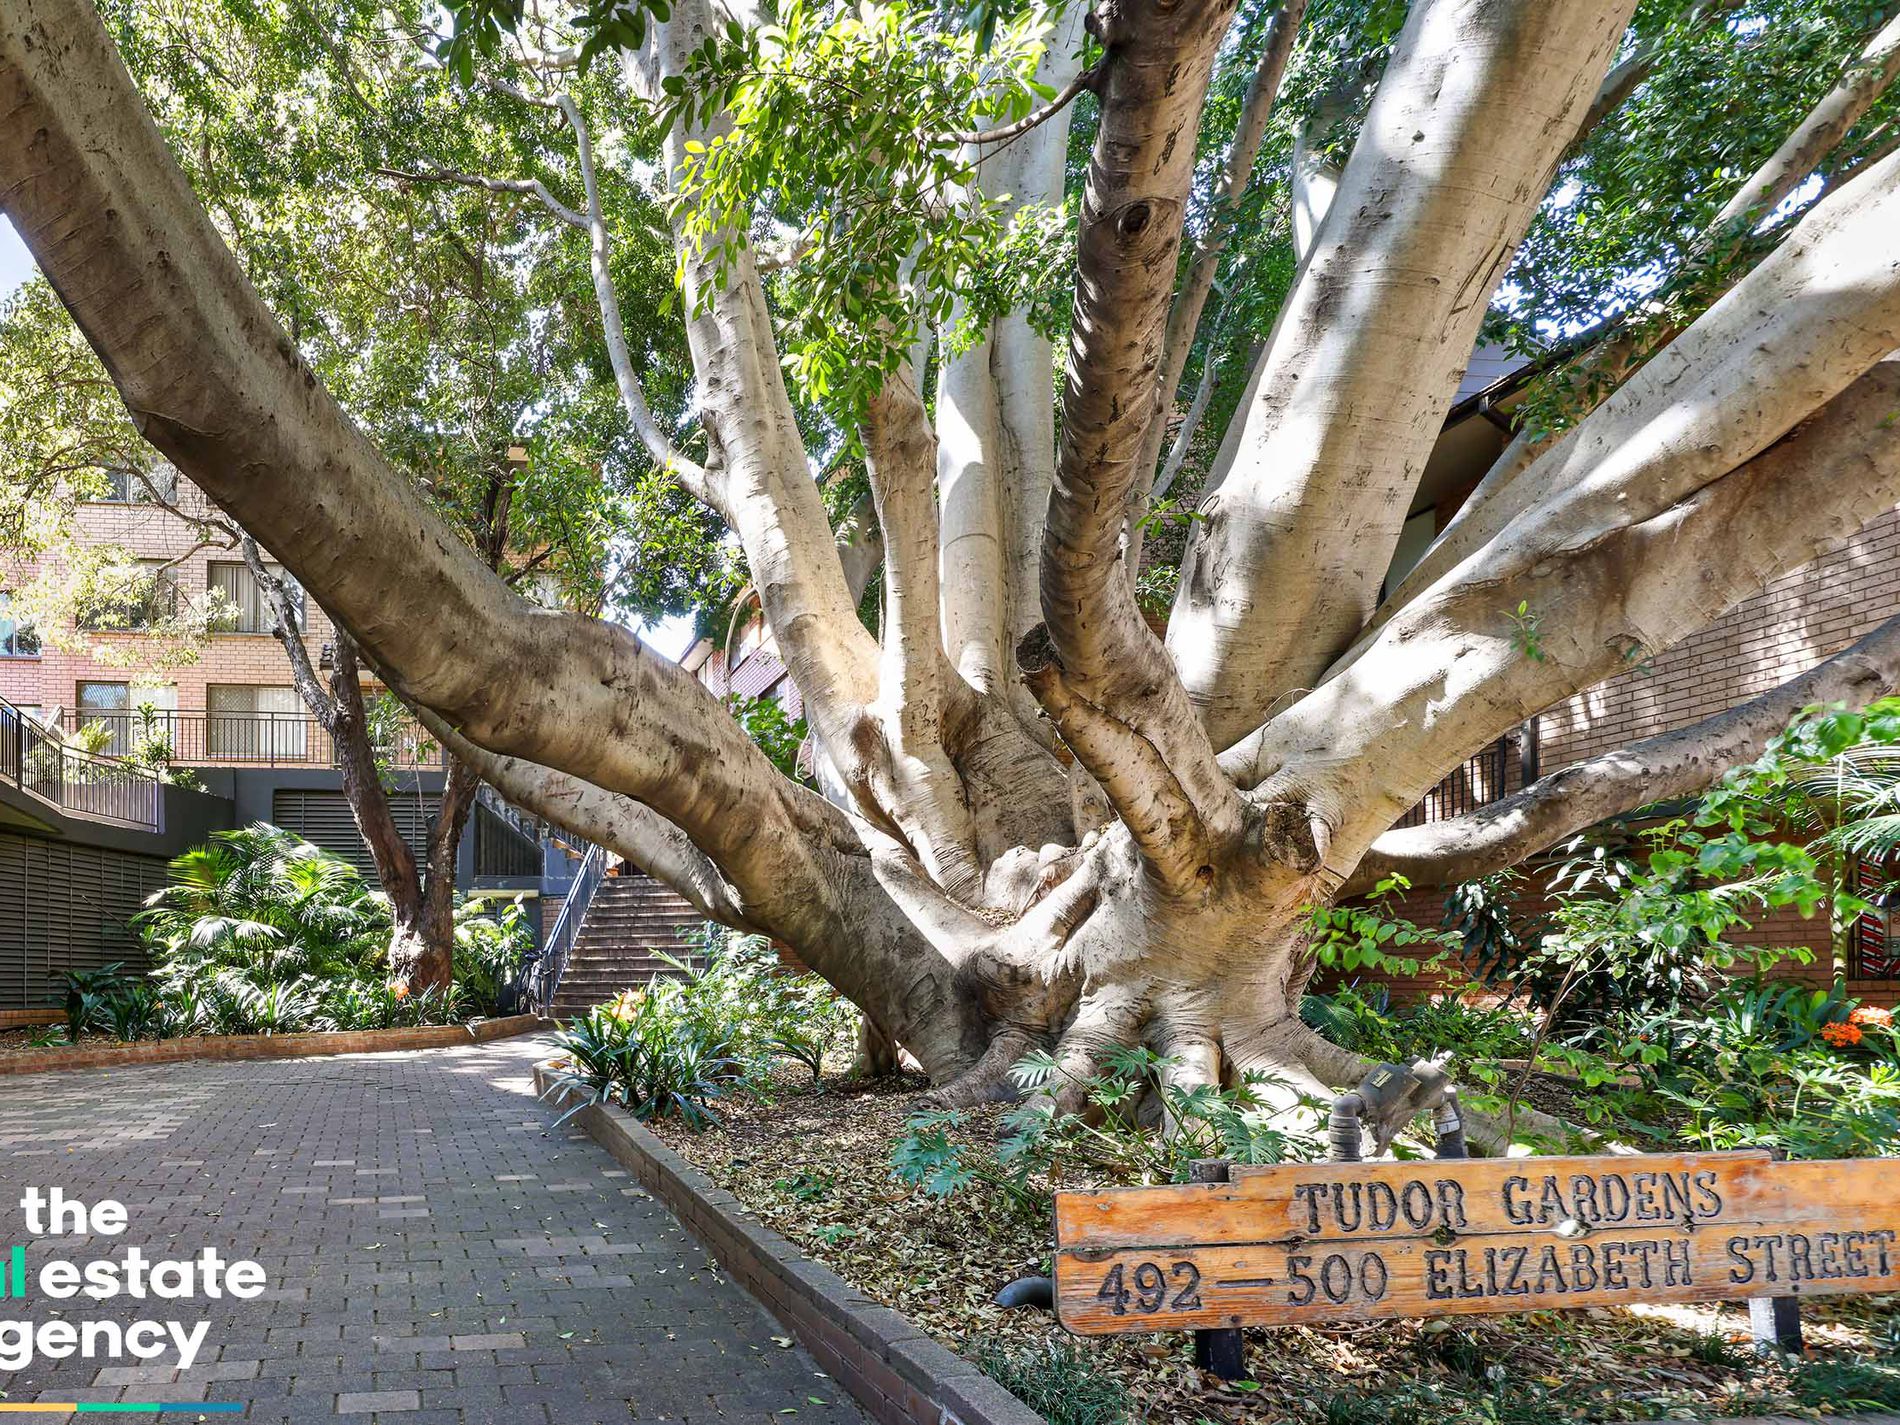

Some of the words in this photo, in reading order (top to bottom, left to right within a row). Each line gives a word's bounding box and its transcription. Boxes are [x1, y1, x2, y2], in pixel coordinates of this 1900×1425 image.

[1295, 1178, 1468, 1233] TUDOR
[1500, 1170, 1724, 1225] GARDENS
[1424, 1238, 1694, 1300] ELIZABETH
[1726, 1229, 1896, 1284] STREET
